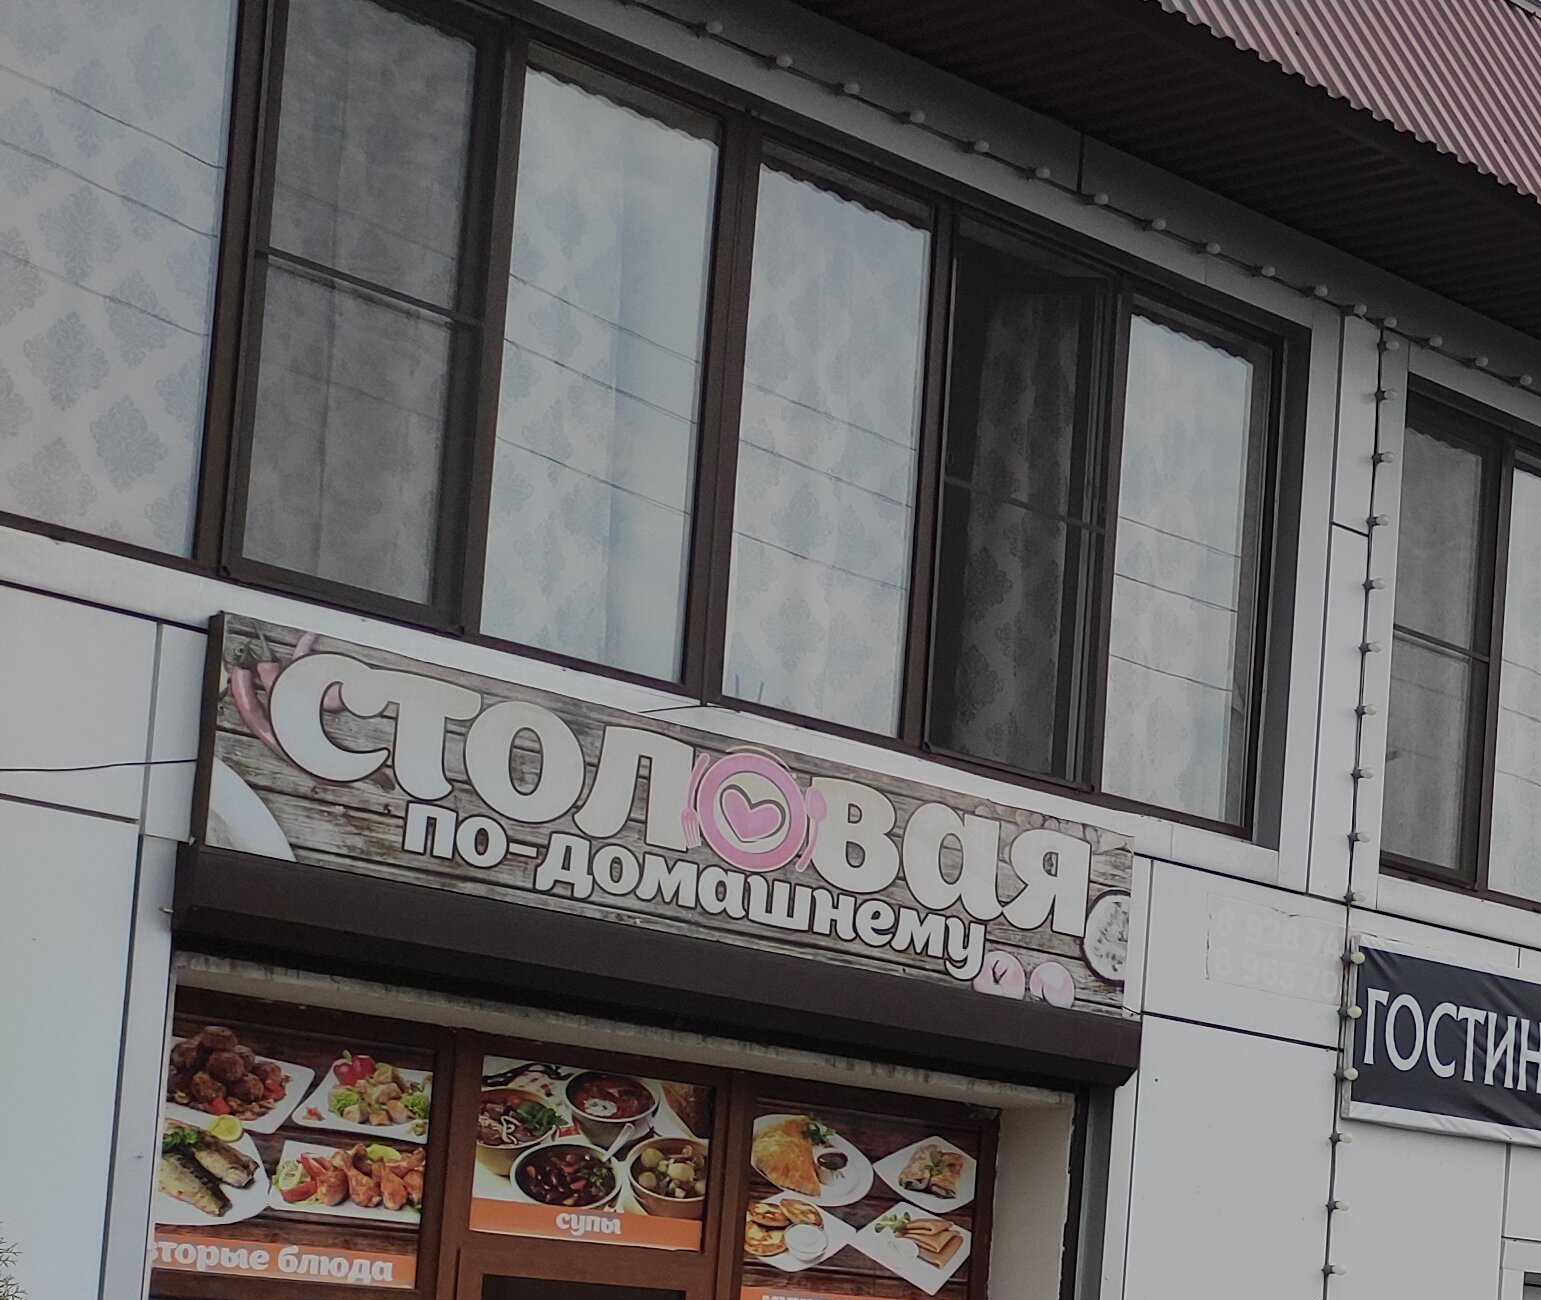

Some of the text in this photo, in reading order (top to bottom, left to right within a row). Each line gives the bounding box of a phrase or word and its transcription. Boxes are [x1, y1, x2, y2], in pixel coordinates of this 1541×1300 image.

[403, 801, 986, 982] по-домашнему
[556, 1213, 622, 1236] супы
[278, 1245, 394, 1284] блюда
